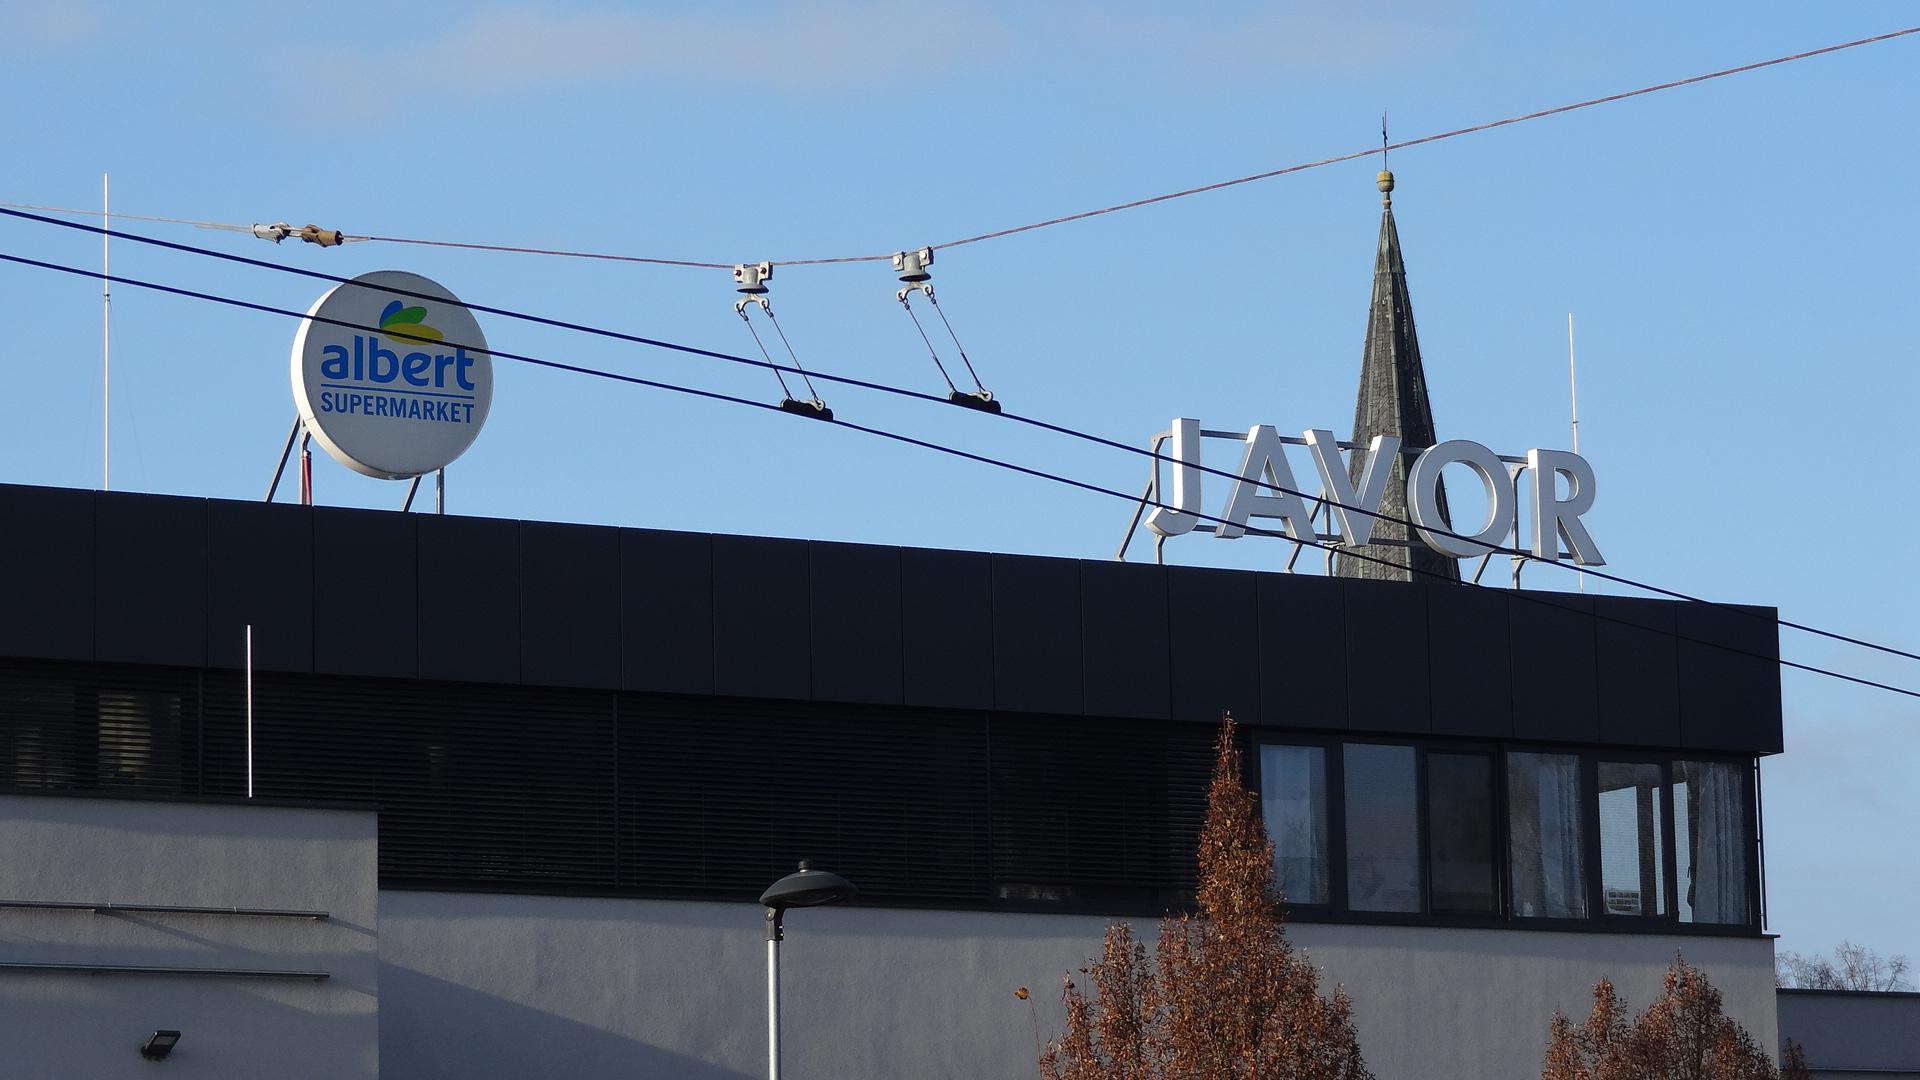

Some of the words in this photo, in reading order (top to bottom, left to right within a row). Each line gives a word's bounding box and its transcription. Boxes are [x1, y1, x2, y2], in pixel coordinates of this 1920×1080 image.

[321, 336, 475, 391] albert
[321, 392, 474, 423] SUPERMARKET
[1145, 418, 1606, 566] JAVOR
